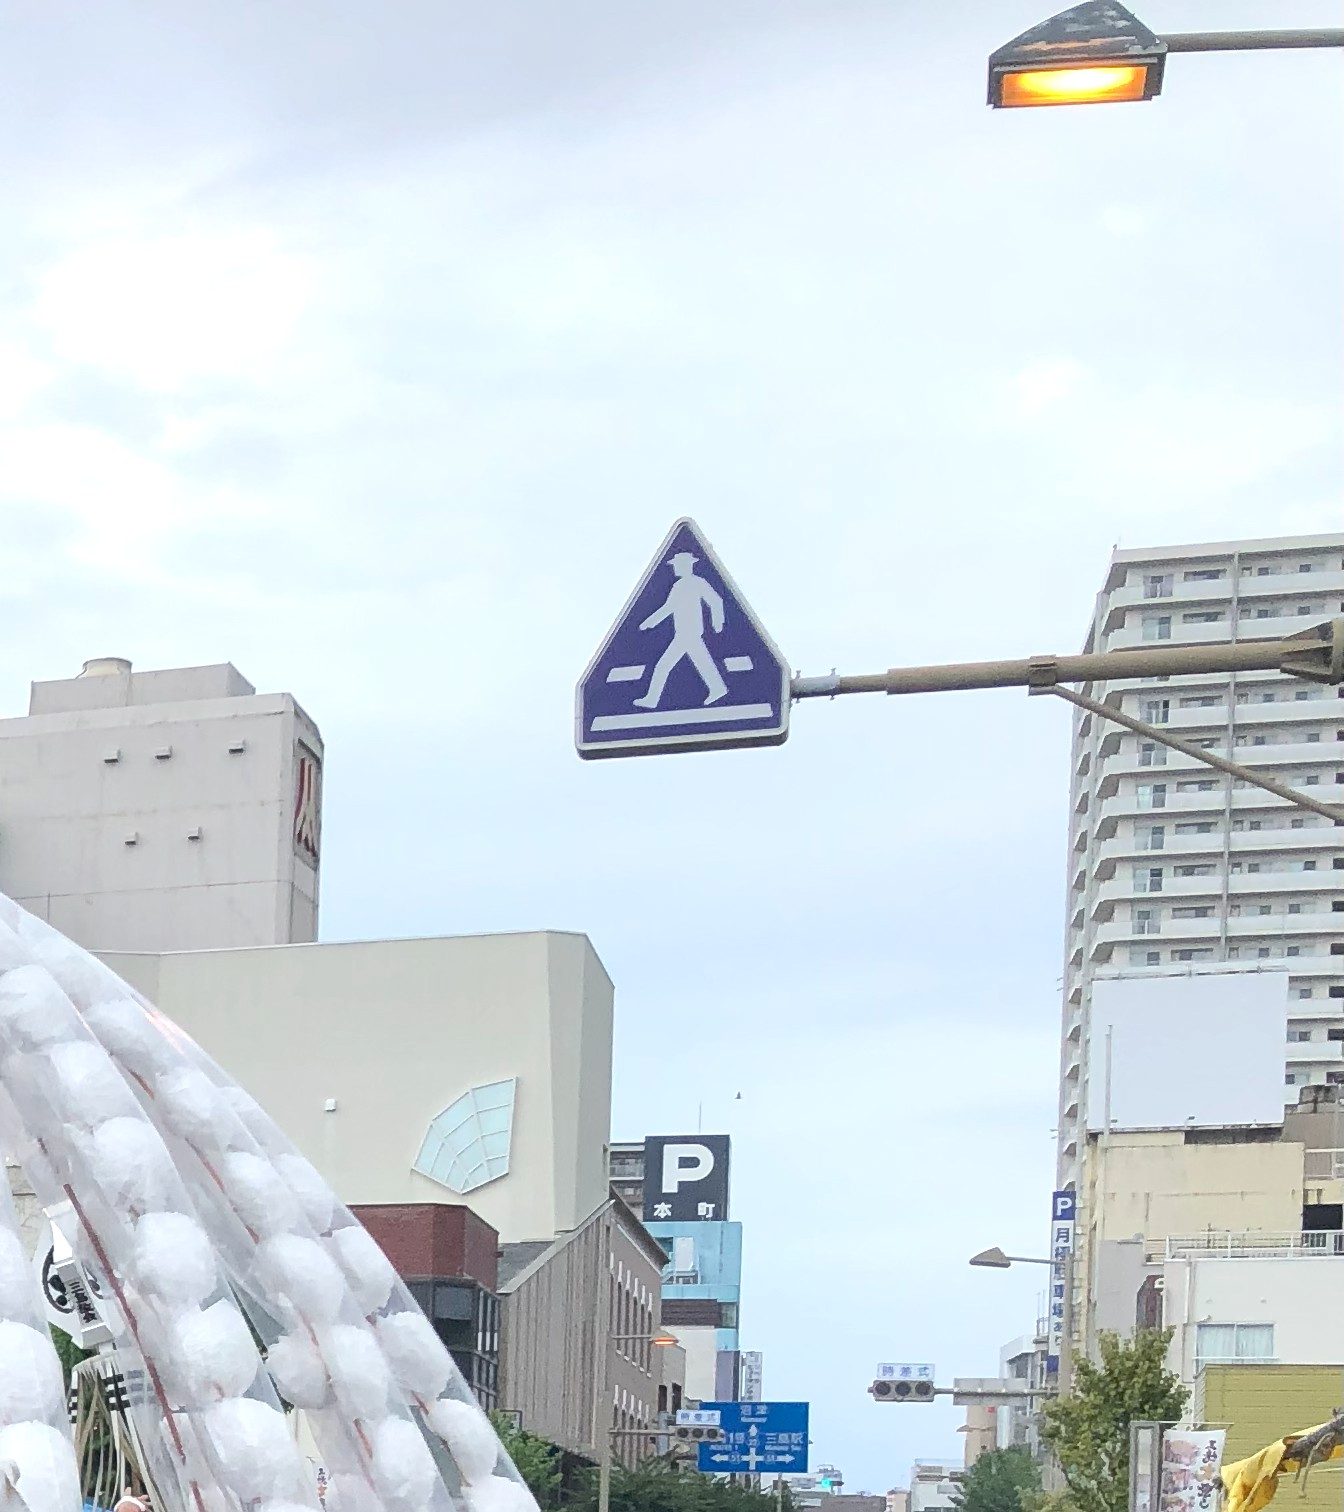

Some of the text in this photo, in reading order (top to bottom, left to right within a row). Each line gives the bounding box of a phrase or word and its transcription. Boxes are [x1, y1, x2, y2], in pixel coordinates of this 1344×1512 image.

[662, 1144, 714, 1193] P
[653, 1202, 715, 1218] 本町
[1057, 1198, 1072, 1216] P
